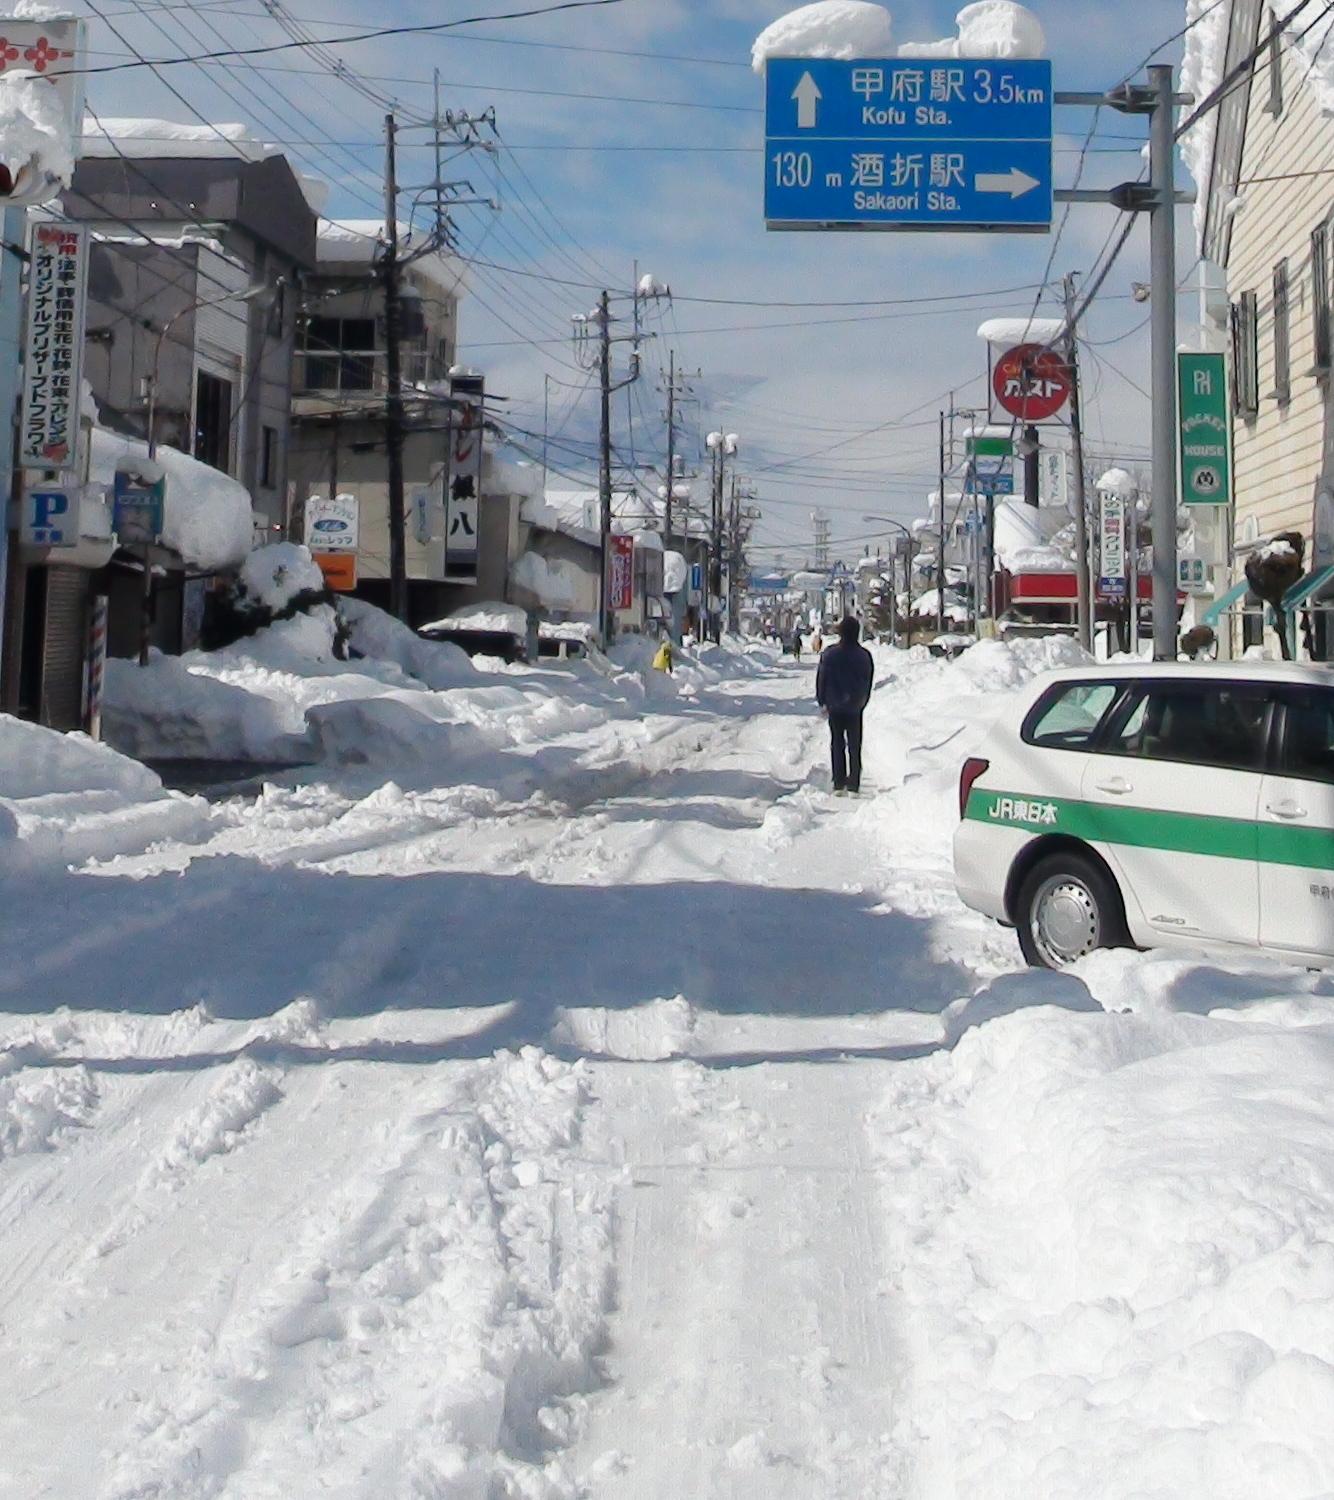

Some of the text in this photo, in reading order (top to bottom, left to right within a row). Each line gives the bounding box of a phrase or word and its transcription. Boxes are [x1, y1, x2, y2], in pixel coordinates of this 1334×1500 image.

[851, 67, 1044, 104] 甲府駅 3.5km
[861, 106, 953, 125] Kofu Sta.
[772, 152, 966, 188] 130 m 酒折駅
[853, 191, 961, 211] Sakaori Sta.
[1181, 412, 1226, 432] POCKET
[1183, 444, 1225, 457] HOUSE
[30, 493, 68, 527] P
[988, 797, 1059, 825] JR東日本
